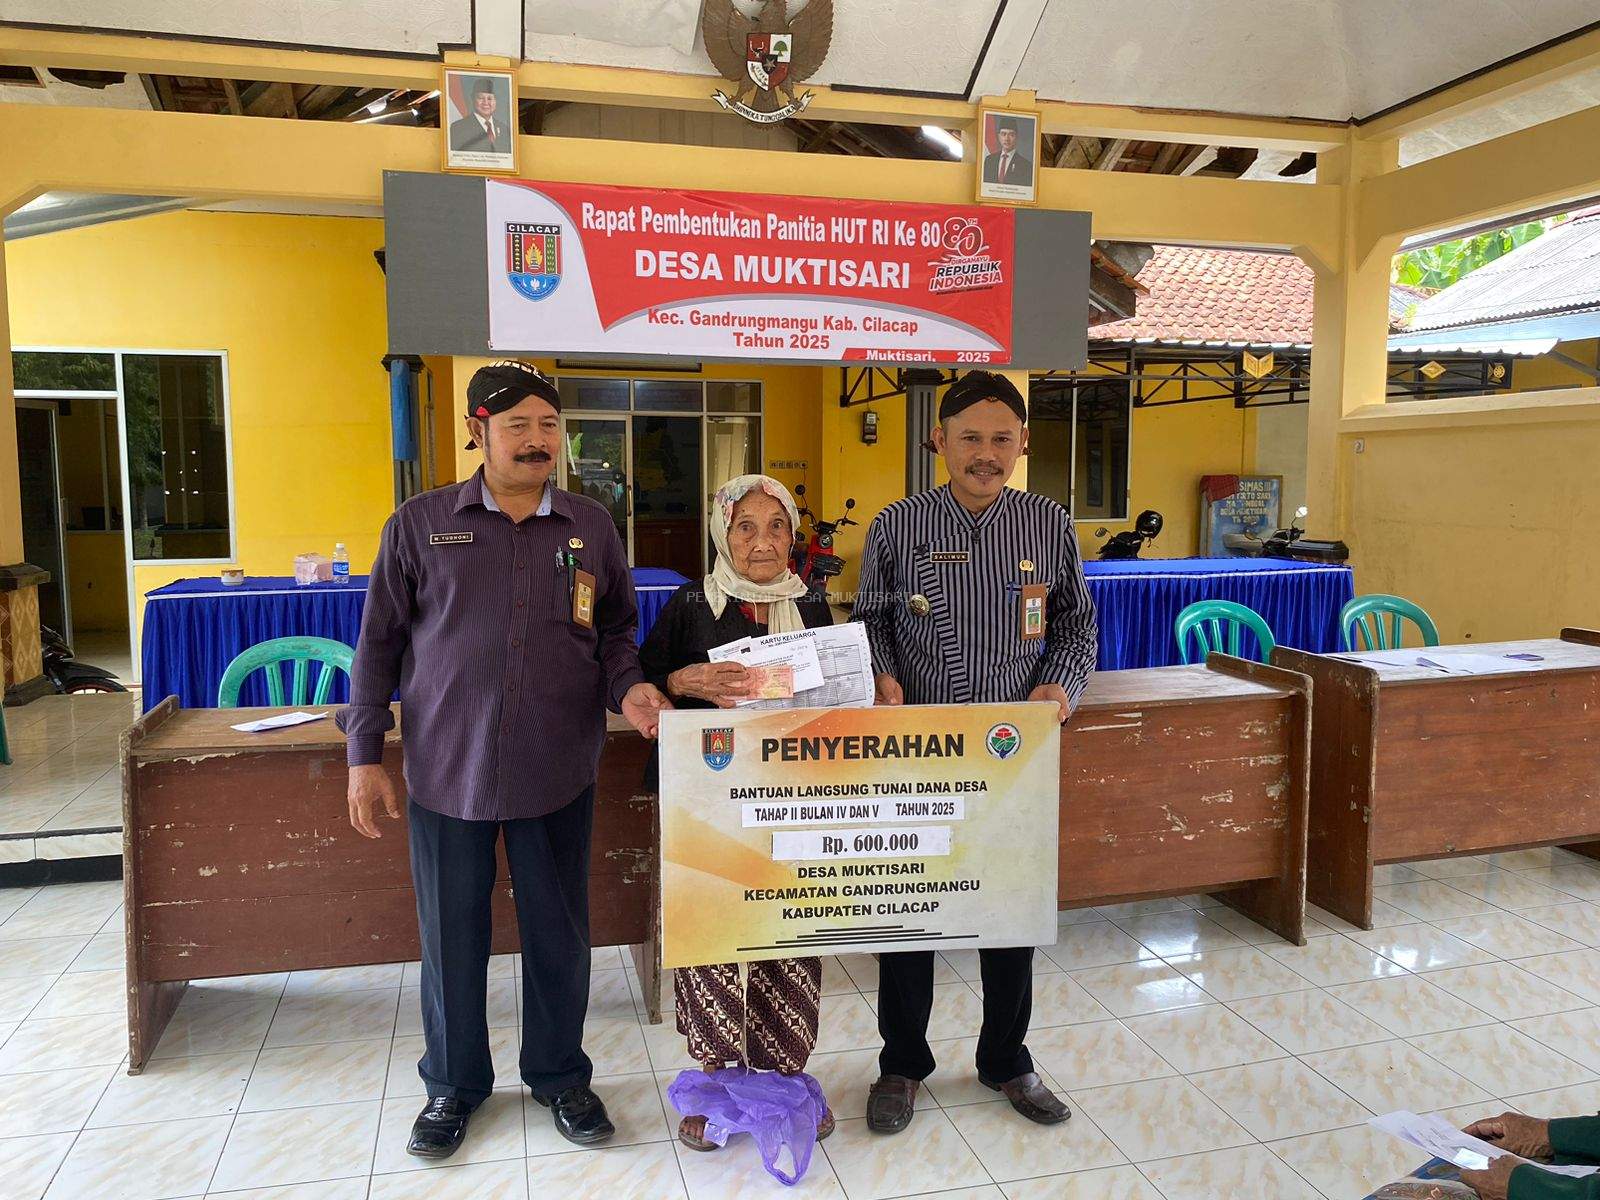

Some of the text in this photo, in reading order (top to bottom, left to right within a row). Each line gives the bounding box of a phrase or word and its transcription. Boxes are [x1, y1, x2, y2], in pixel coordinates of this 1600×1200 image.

[508, 224, 559, 234] CILACAP
[582, 202, 941, 248] Rapat Pembentukan Panitia HUT RI Ke 80
[635, 249, 910, 289] DESA MUKTISARI
[936, 261, 1000, 277] REPUBLIK
[929, 272, 1001, 290] INDONESIA
[648, 309, 918, 336] Kec. Gandrungmangu Kab. Cilacap
[732, 332, 830, 350] Tahun 2025
[957, 351, 990, 363] 2025
[760, 637, 781, 646] KARTU
[782, 630, 817, 642] KELUARGA
[761, 733, 965, 763] PENYERAHAN
[730, 780, 988, 800] BANTUAN LANGSUNG TUNAI DANA DESA
[754, 801, 955, 822] TAHAP II BULAN IV DAN V TAHUN 2025
[822, 833, 919, 855] Rp. 600.000
[797, 862, 924, 879] DESA MUKTISARI
[744, 879, 980, 902] KECAMATAN GANDRUNGMANGU
[782, 901, 940, 920] KABUPATEN CILACAP
